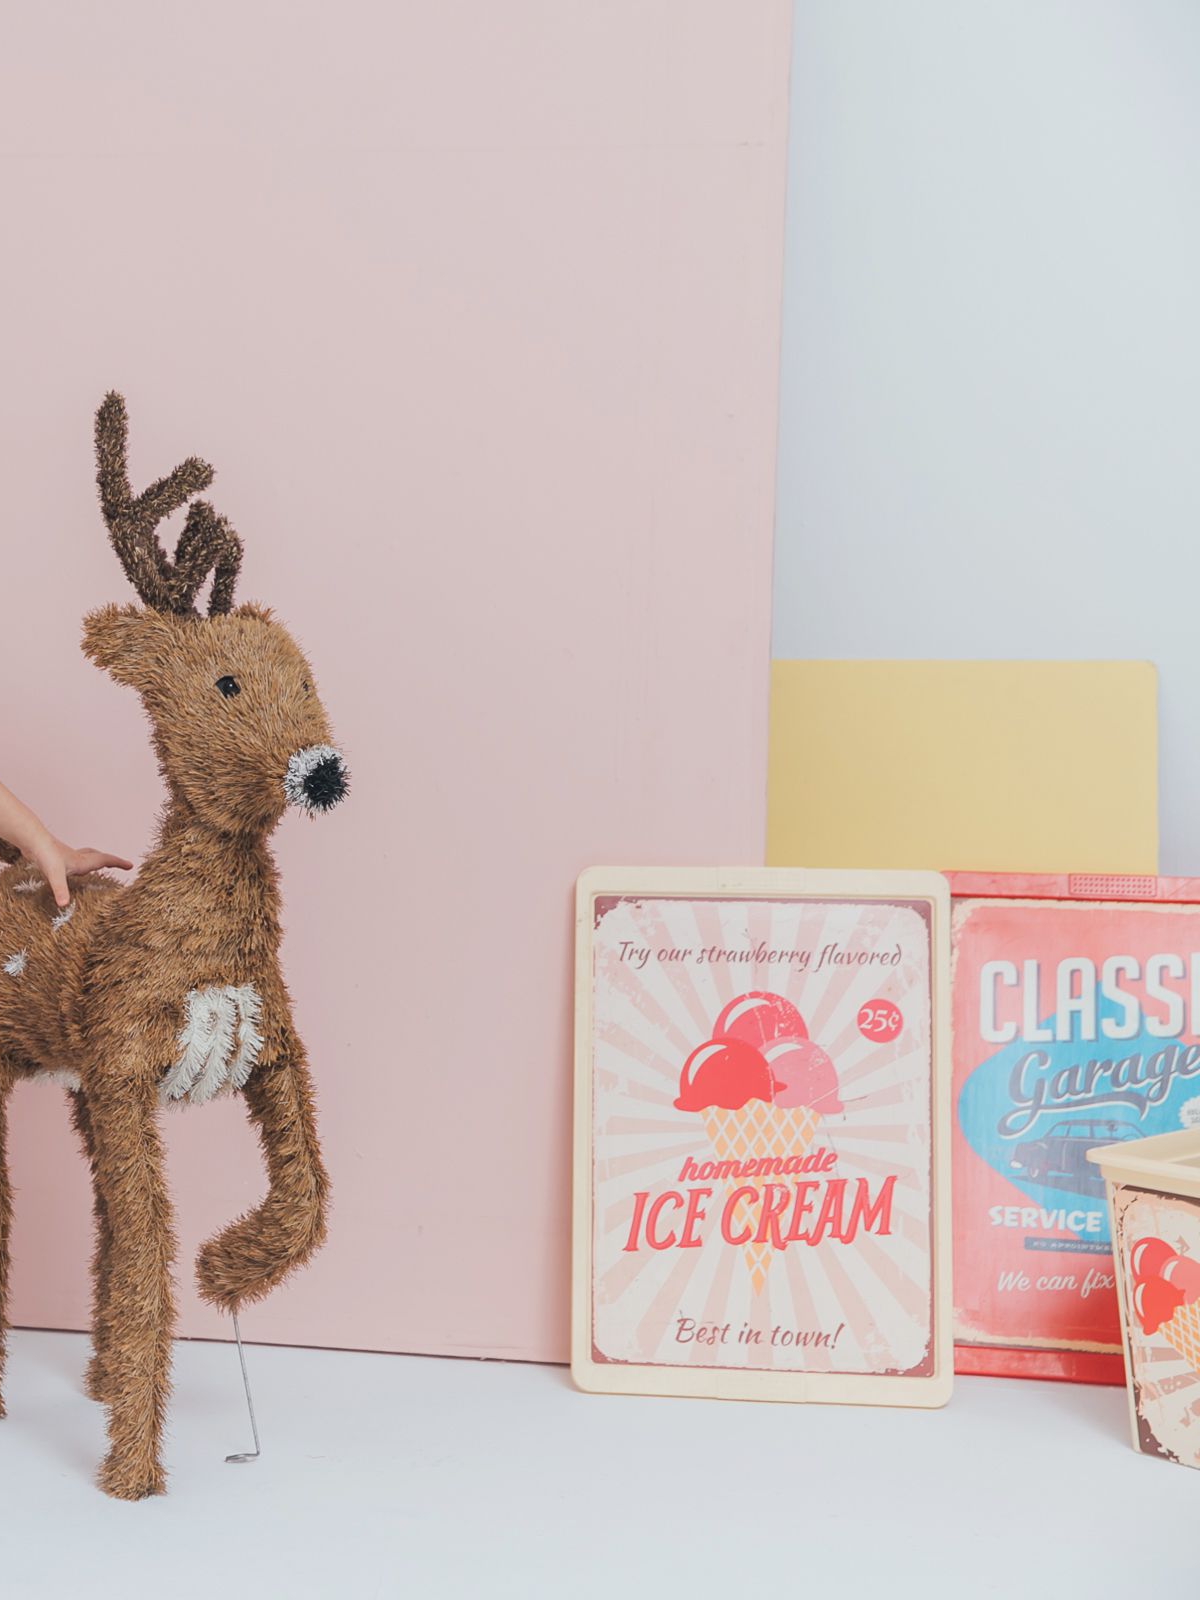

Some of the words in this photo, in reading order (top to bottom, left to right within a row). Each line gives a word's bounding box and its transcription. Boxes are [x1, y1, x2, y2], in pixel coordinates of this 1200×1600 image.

[619, 941, 650, 969] Try
[657, 947, 691, 962] our
[696, 941, 810, 972] strawberry
[813, 943, 902, 973] flavored
[997, 1045, 1200, 1139] Garage
[678, 1147, 838, 1182] homemade
[622, 1188, 712, 1252] ICE
[721, 1175, 897, 1251] CREAM
[988, 1205, 1104, 1233] SERVICE
[997, 1271, 1030, 1292] We
[1036, 1275, 1078, 1291] can
[1080, 1268, 1115, 1299] fix
[675, 1317, 731, 1346] Best
[738, 1322, 761, 1345] in
[770, 1322, 845, 1349] town!
